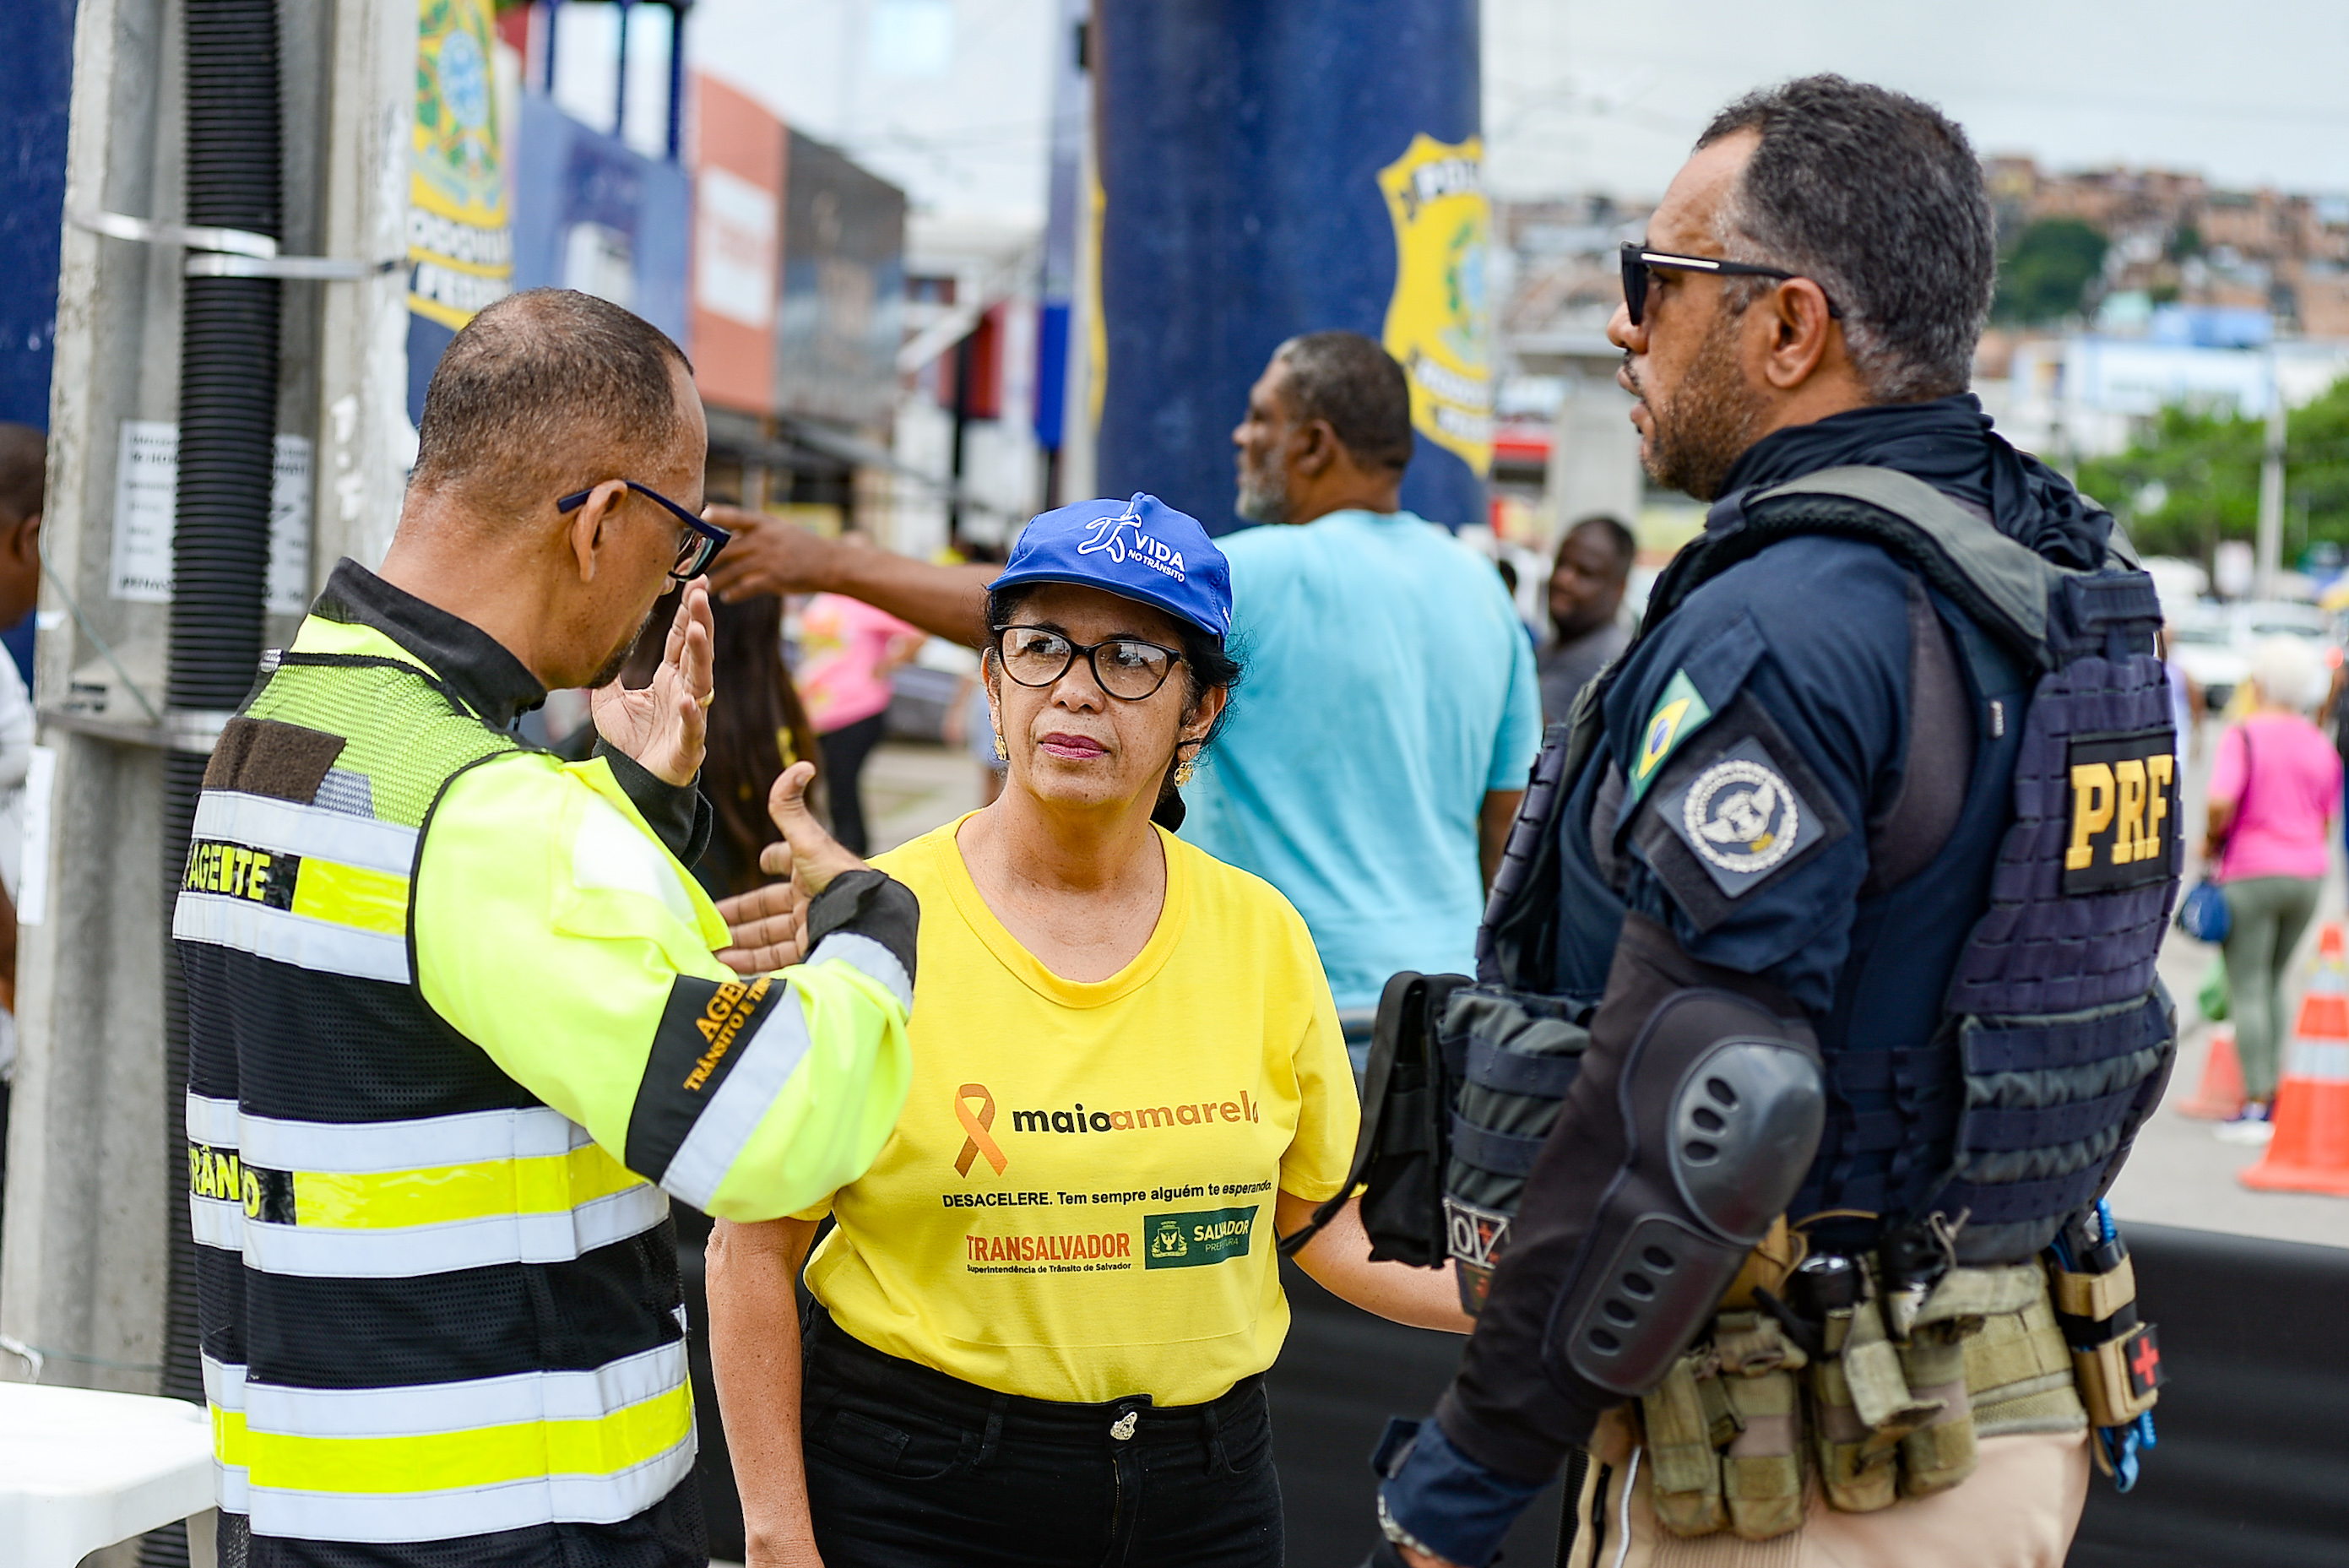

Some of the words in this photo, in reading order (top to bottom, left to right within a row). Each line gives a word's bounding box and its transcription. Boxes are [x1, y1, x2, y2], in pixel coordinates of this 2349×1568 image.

[1127, 548, 1142, 562] NO
[1142, 557, 1185, 583] TRÂNSITO
[1135, 529, 1185, 572] VIDA
[2065, 754, 2173, 871] PRF
[682, 1012, 746, 1091] TRÂNSITO
[942, 1191, 1053, 1208] DESACELERE.
[1057, 1191, 1088, 1205] Tem
[1092, 1191, 1147, 1206] sempre
[1151, 1184, 1204, 1202] alguém
[1208, 1182, 1220, 1196] te
[1223, 1179, 1272, 1197] esperando.
[1194, 1219, 1250, 1242] SALVADOR
[966, 1233, 1131, 1261] TRANSALVADOR
[967, 1264, 1036, 1274] Superintendência
[1049, 1264, 1082, 1273] Trânsito
[1083, 1263, 1094, 1272] de
[1096, 1261, 1132, 1272] Salvador
